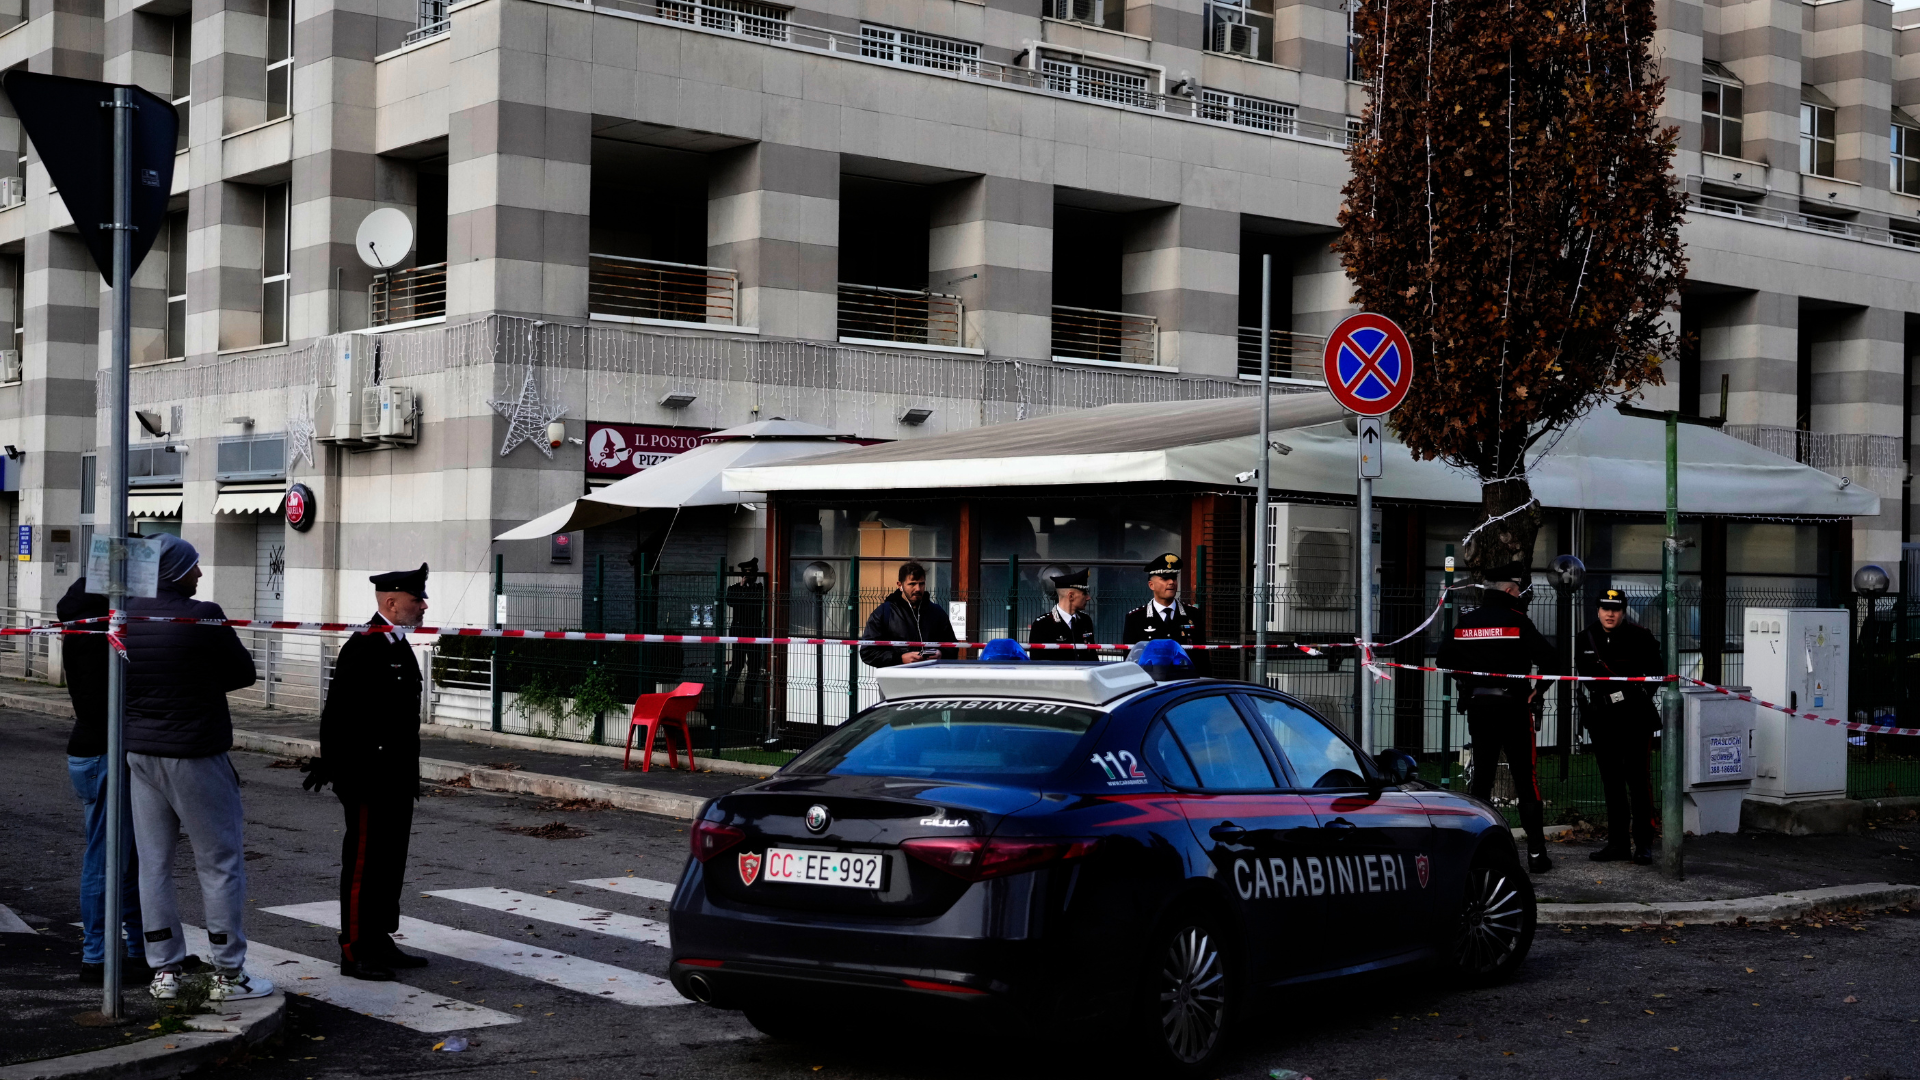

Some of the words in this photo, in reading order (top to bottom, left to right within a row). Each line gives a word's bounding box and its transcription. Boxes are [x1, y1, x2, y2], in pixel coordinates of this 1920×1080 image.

[635, 434, 649, 446] IL
[651, 434, 698, 449] POSTO
[1462, 628, 1503, 637] CARABINIERI
[896, 700, 1067, 716] CARABINIERI
[1090, 750, 1146, 780] 112
[920, 819, 970, 827] GIULIA
[770, 853, 793, 877] CC
[806, 855, 830, 880] EE
[840, 858, 877, 884] 992
[1233, 854, 1407, 900] CARABINIERI
